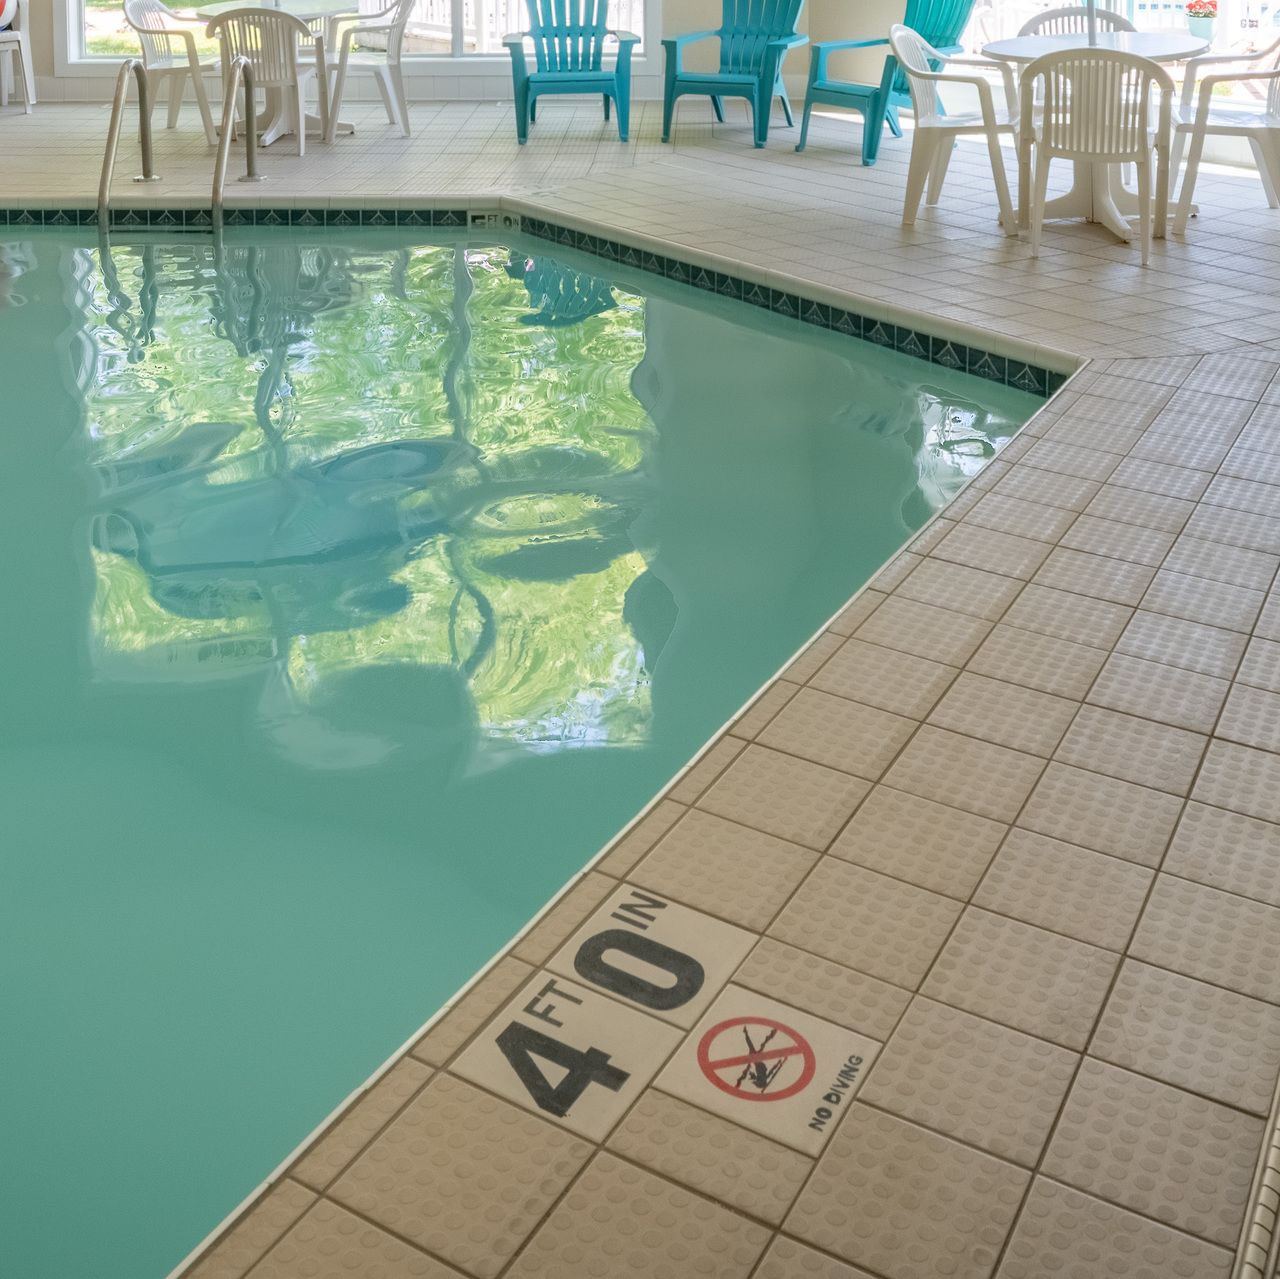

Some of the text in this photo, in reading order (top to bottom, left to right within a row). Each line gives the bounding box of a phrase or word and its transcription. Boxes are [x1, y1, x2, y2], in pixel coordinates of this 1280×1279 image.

[495, 890, 705, 1118] 4 FT 0 IN
[807, 1053, 864, 1132] NO DIVING
